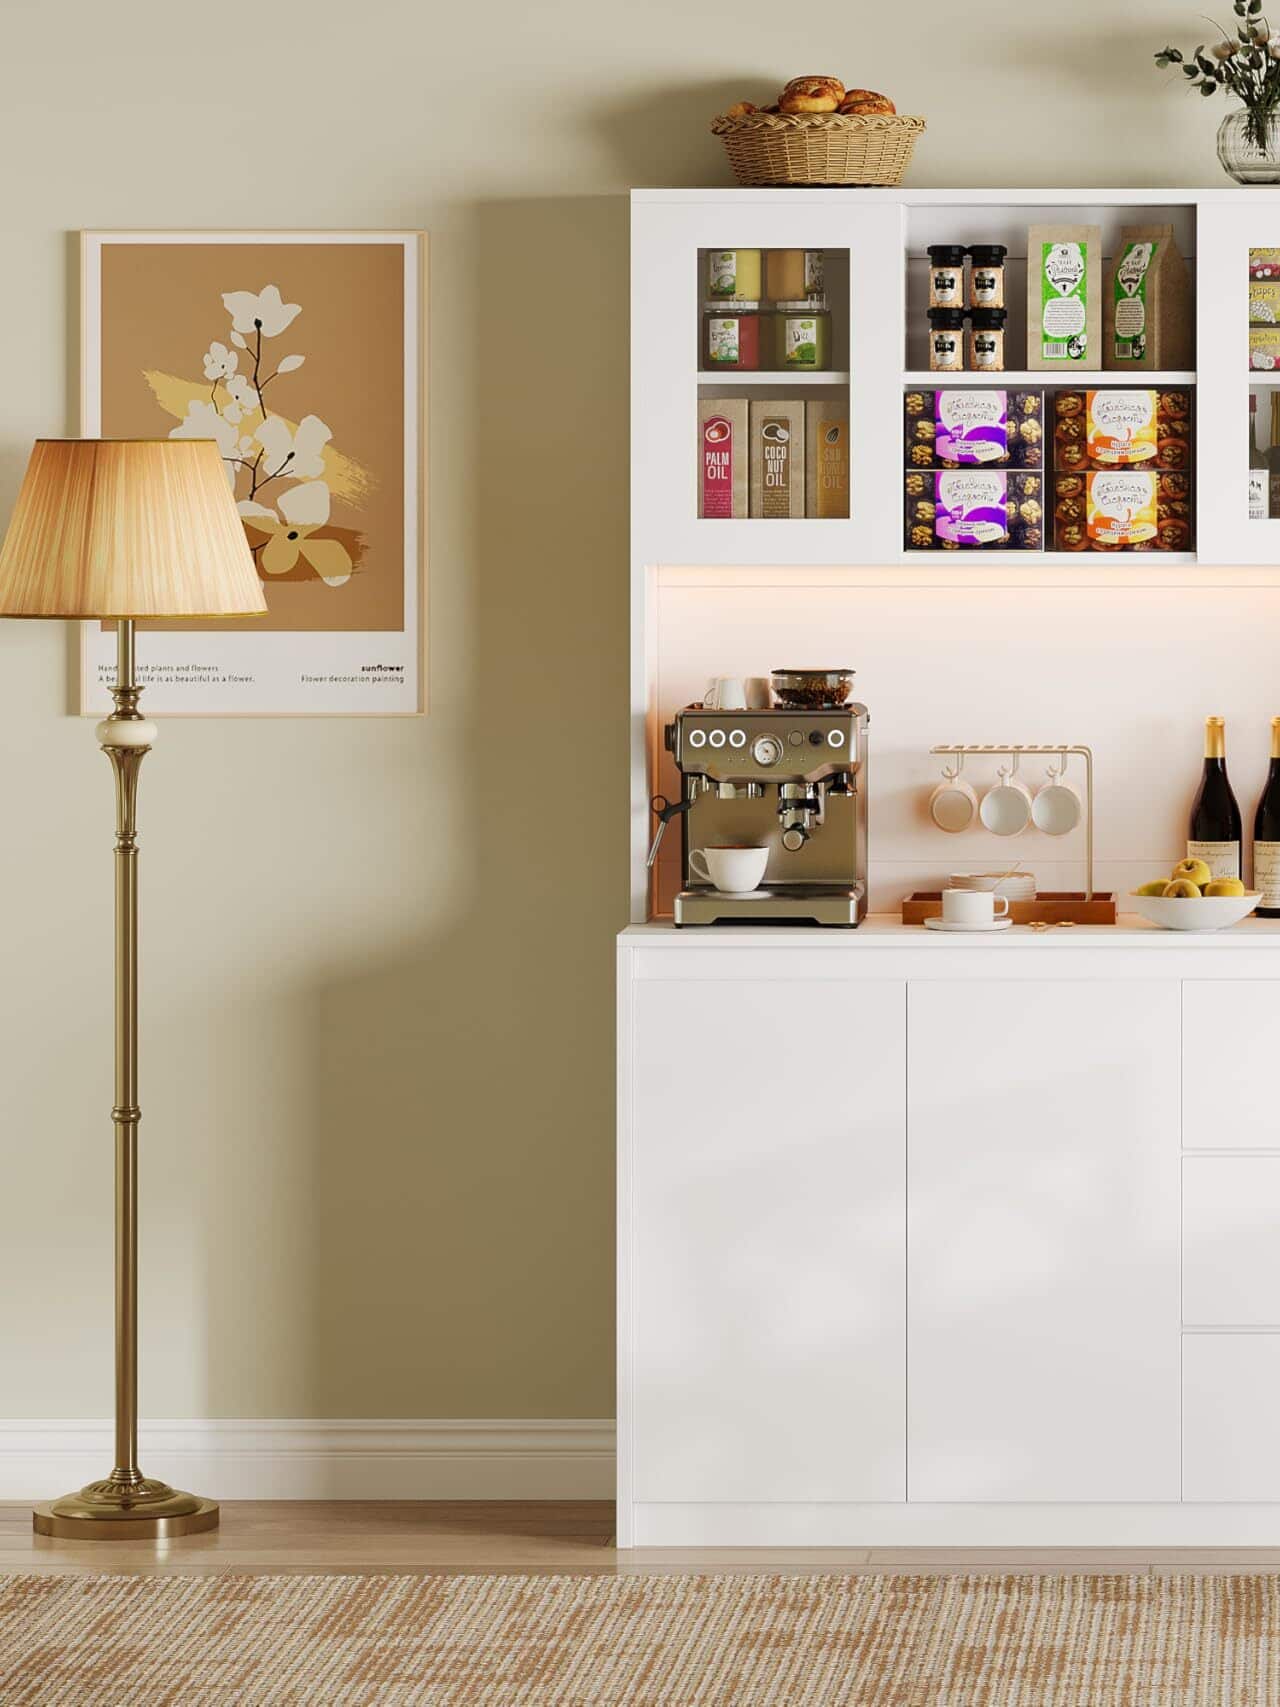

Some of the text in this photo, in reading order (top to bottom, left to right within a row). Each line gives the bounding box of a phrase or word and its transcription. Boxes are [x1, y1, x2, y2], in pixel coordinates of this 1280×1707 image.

[705, 452, 730, 466] PALM
[764, 446, 787, 460] COCO
[707, 465, 729, 479] OIL
[767, 459, 784, 473] NUT
[766, 473, 787, 487] OIL
[151, 665, 174, 673] plants
[176, 664, 190, 672] and
[191, 664, 219, 672] flowers
[361, 664, 404, 672] sunflower
[175, 674, 210, 682] beautiful
[329, 674, 370, 682] decoration
[372, 674, 404, 684] painting
